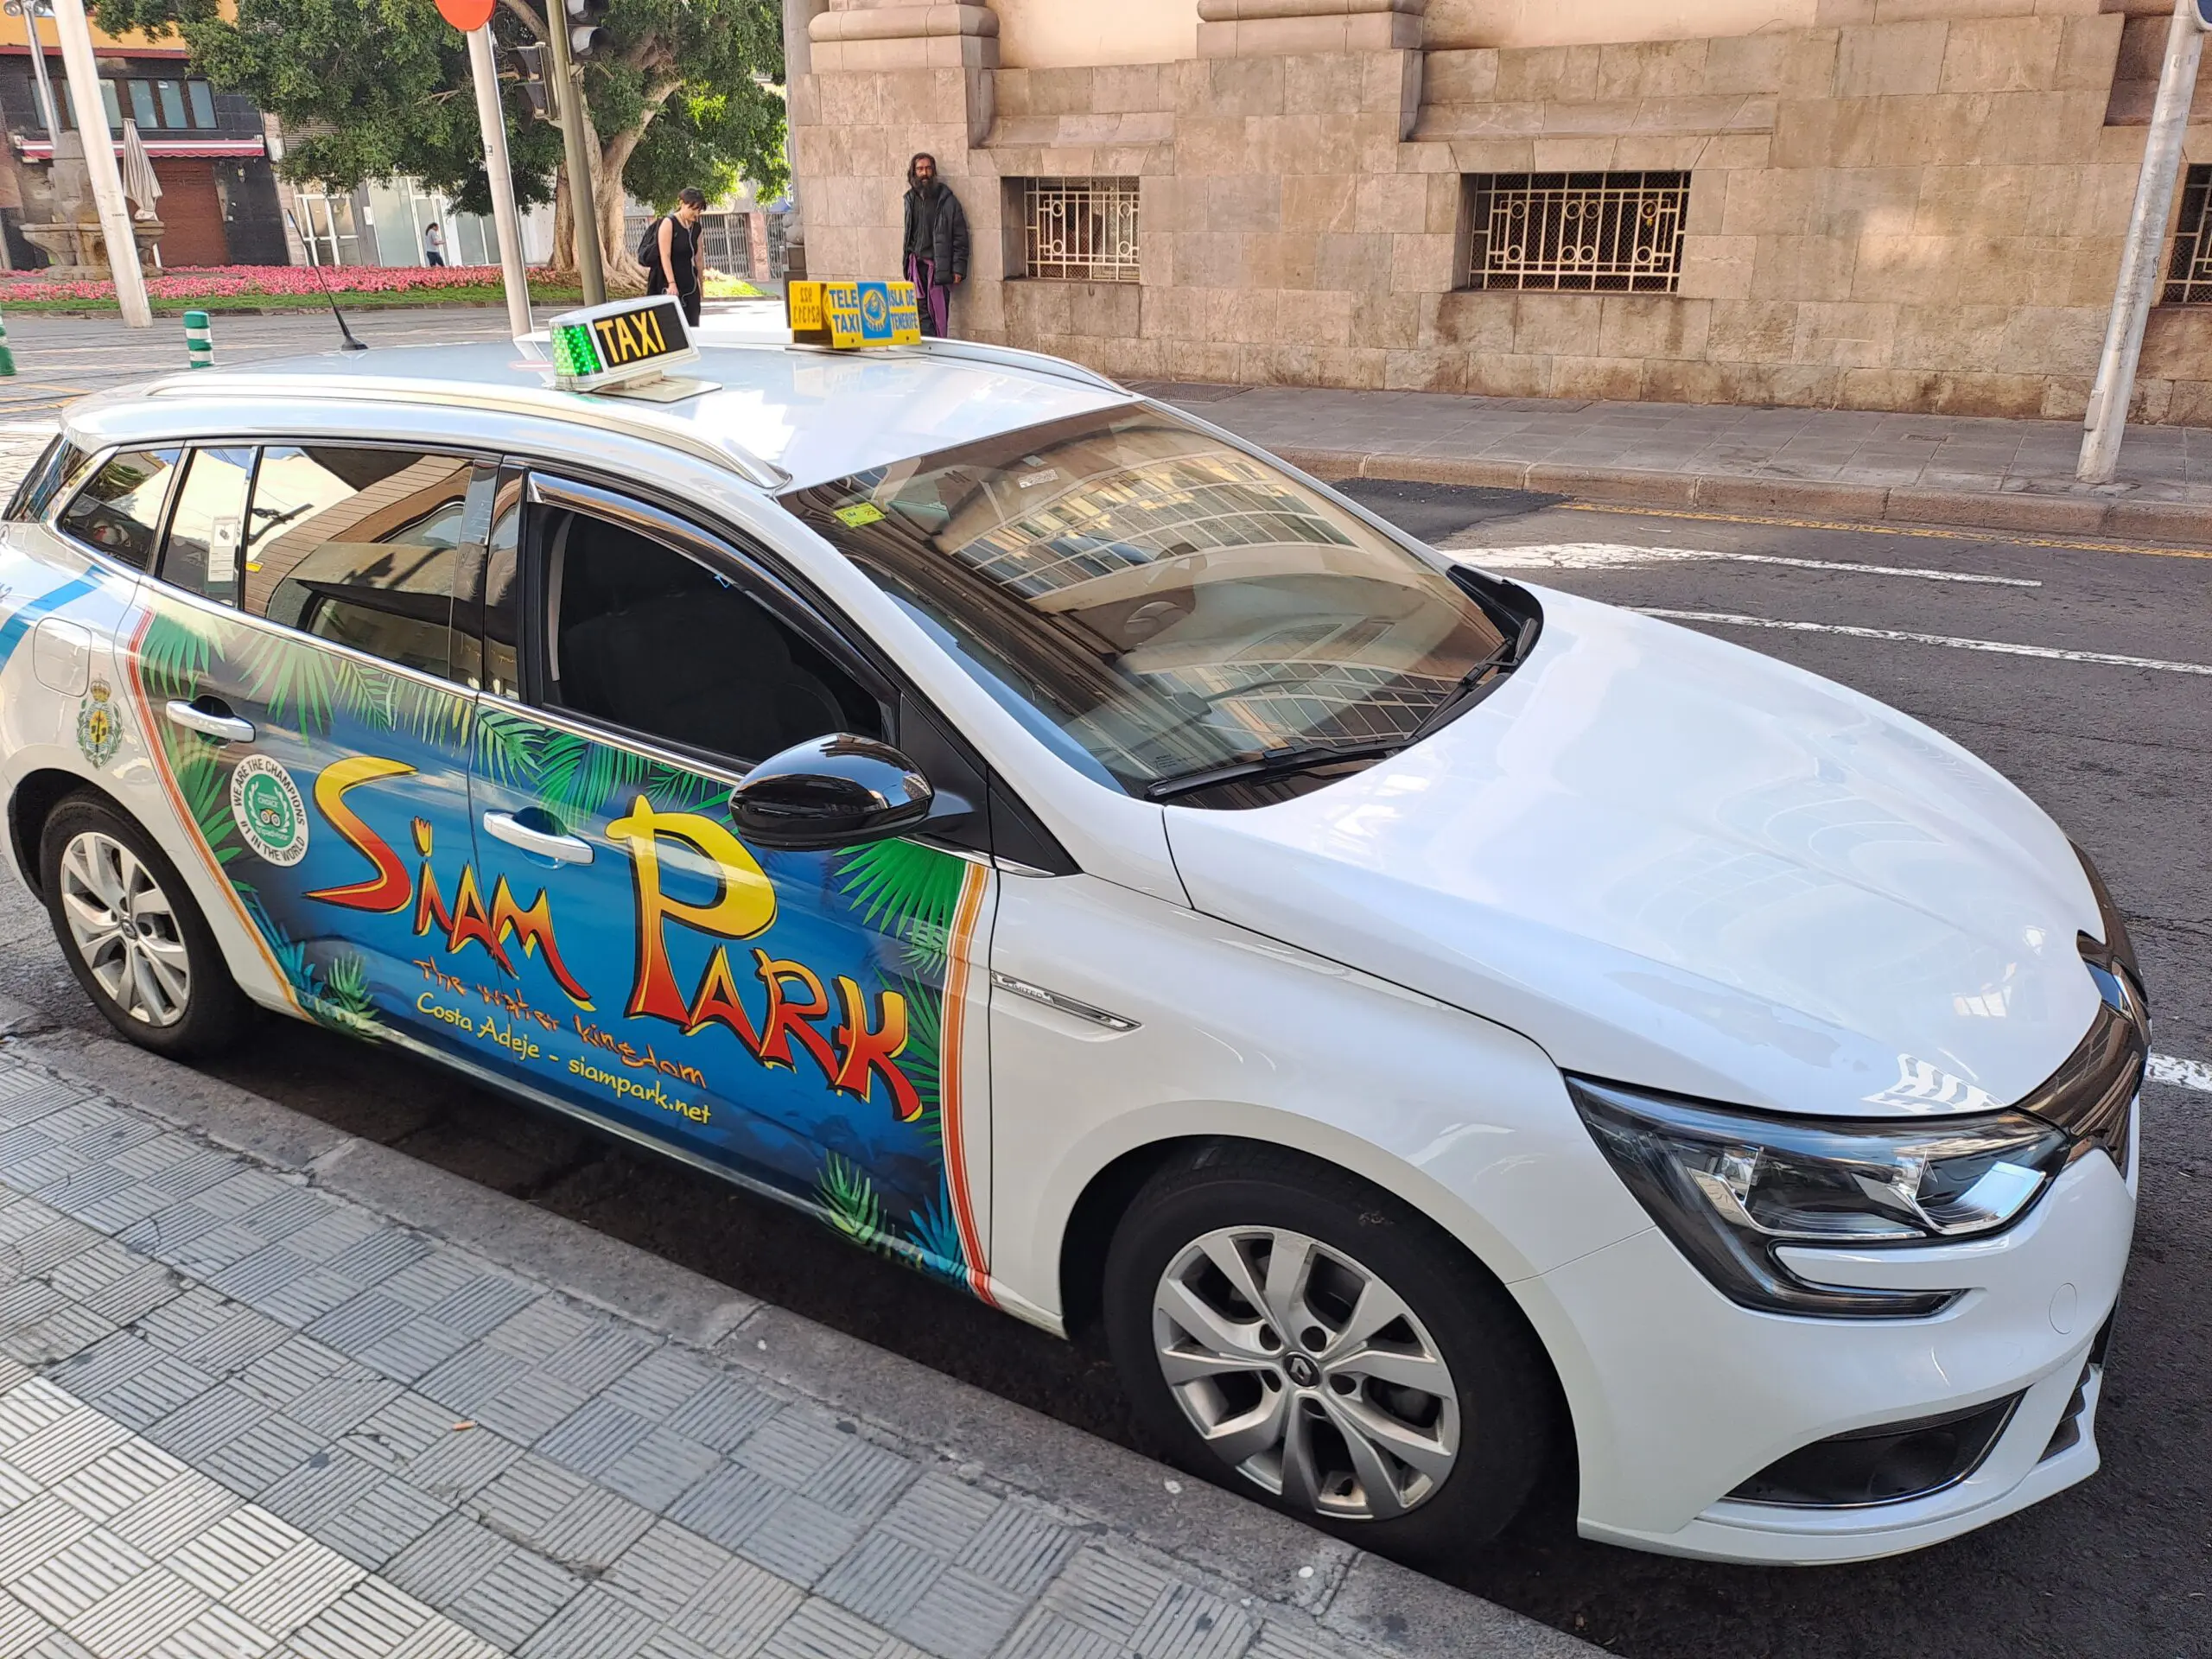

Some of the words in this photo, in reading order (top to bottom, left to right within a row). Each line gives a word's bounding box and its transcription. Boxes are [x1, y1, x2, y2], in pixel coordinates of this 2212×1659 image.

[829, 289, 859, 308] TELE
[888, 289, 906, 307] ISLA
[906, 289, 916, 306] DE
[832, 314, 861, 334] TAXI
[891, 312, 918, 330] TENERIFE
[594, 310, 667, 363] TAXI
[246, 759, 264, 772] THE
[235, 766, 250, 788] ARE
[233, 786, 243, 806] WE
[265, 760, 305, 826] CHAMPIONS
[251, 835, 261, 848] IN
[264, 844, 282, 861] THE
[281, 836, 305, 861] WORLD
[416, 992, 474, 1032] Costa
[477, 1016, 540, 1061] Adeje
[568, 1056, 712, 1124] siampark.net
[573, 1014, 707, 1090] kingdom
